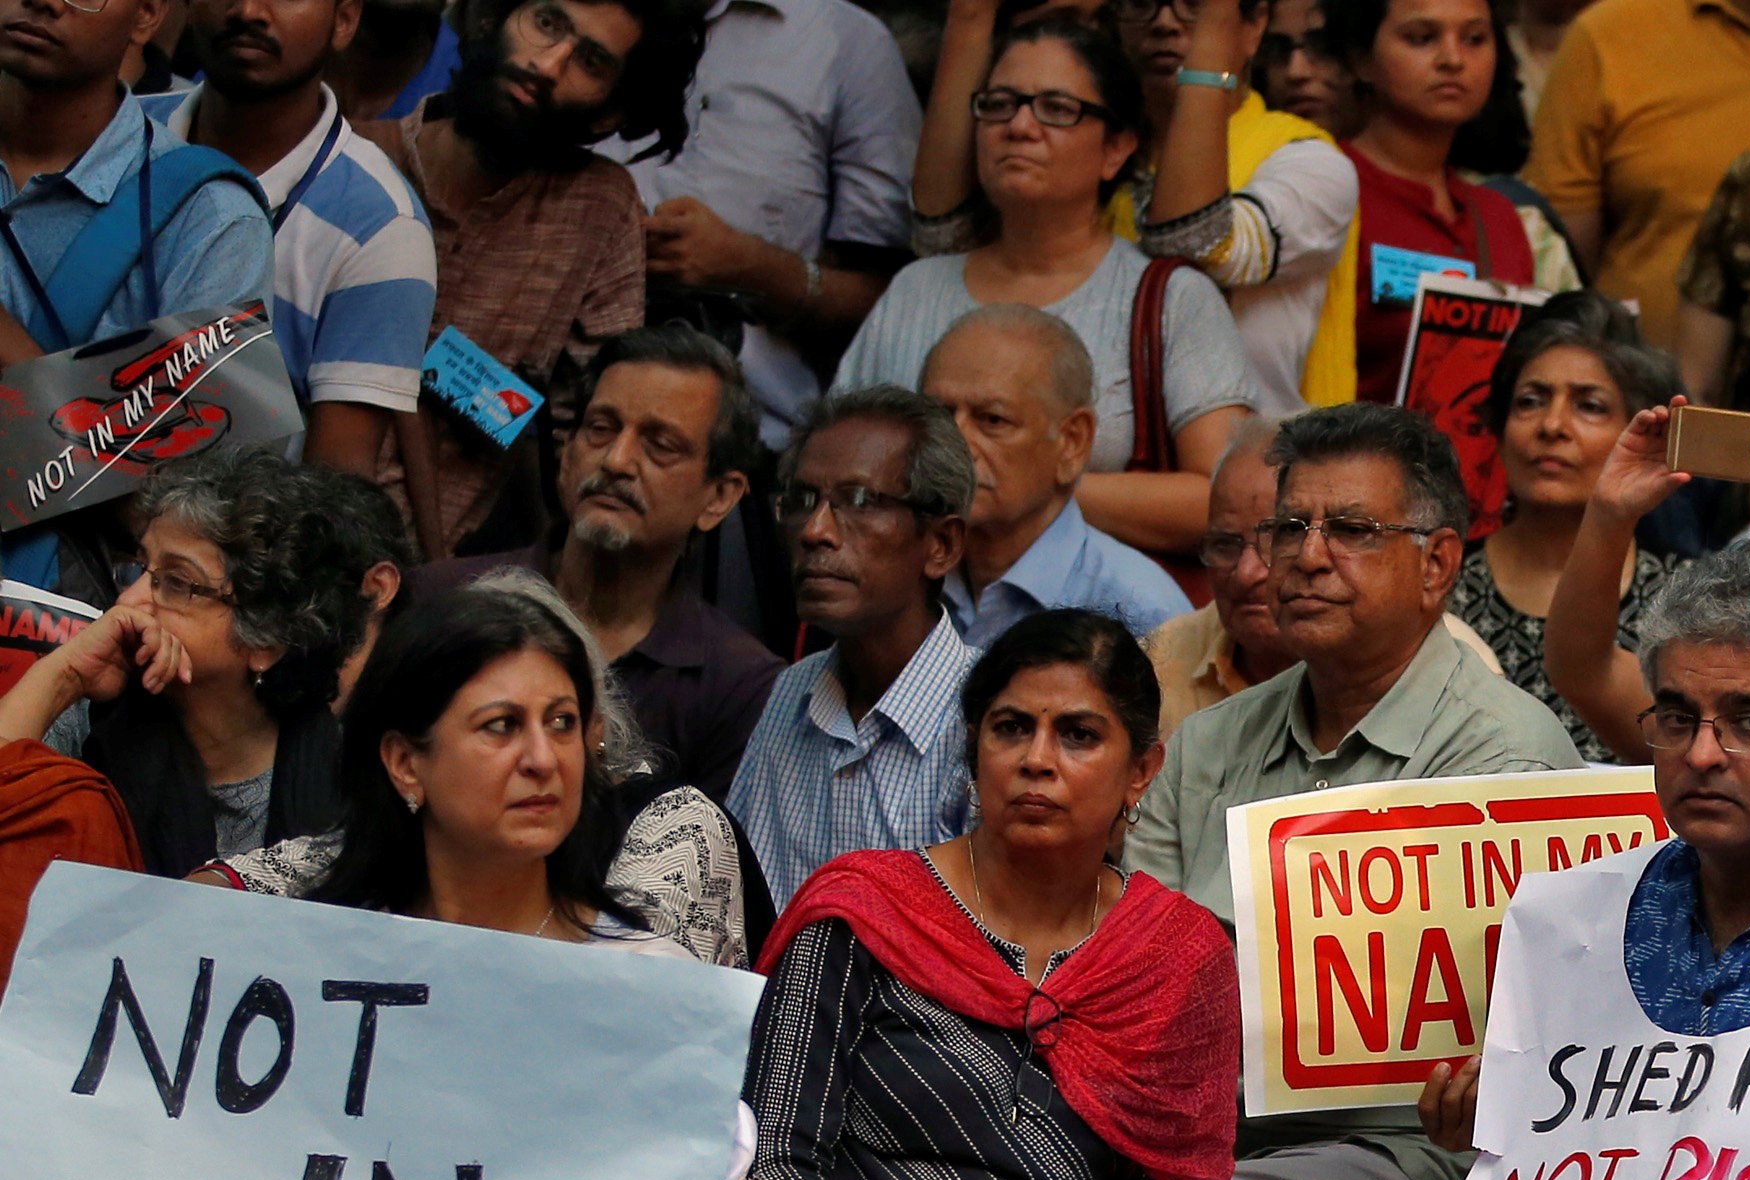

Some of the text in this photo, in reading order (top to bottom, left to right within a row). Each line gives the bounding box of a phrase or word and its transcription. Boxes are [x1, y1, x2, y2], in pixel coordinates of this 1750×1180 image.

[1422, 295, 1521, 334] NOT IN
[27, 316, 236, 508] NOT IN MY NAME
[1309, 844, 1439, 918] NOT
[1460, 839, 1522, 909] IN
[71, 956, 430, 1119] NOT
[1313, 923, 1503, 1056] NA
[1531, 1041, 1715, 1134] SHED
